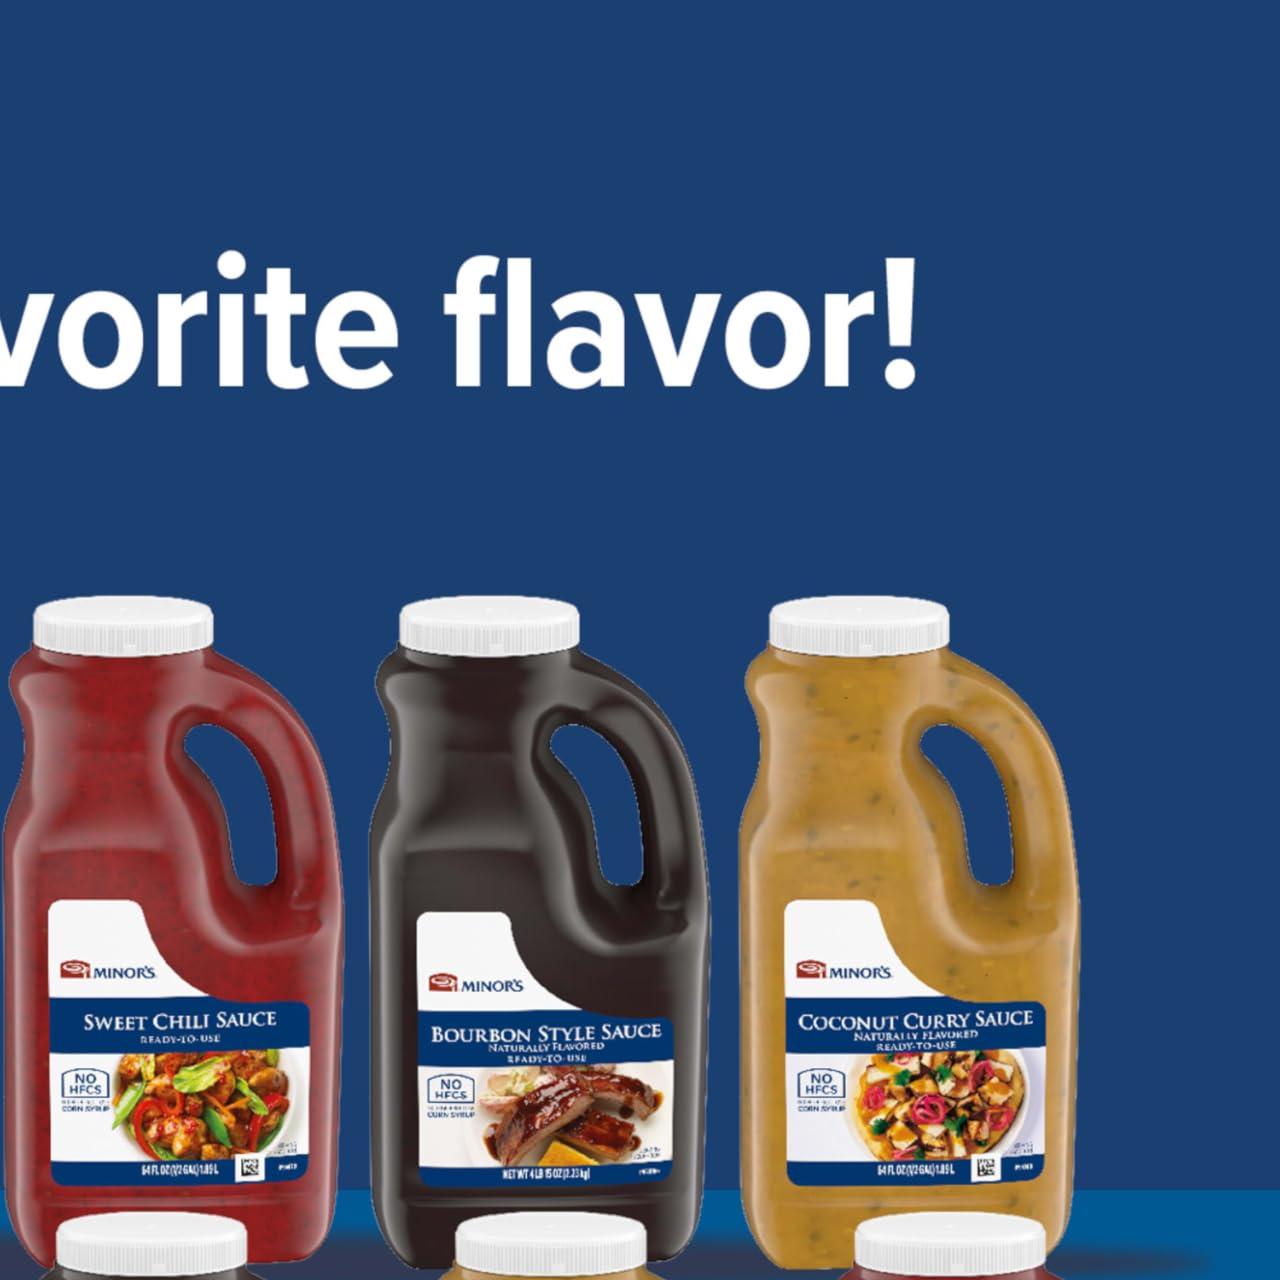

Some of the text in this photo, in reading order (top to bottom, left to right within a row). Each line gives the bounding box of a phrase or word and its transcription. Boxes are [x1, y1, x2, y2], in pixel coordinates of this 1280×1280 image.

[93, 966, 155, 979] MINOR'S
[829, 966, 891, 979] MINOR'S
[461, 979, 523, 993] MINOR'S
[84, 1011, 277, 1031] SWEET CHILI SAUCE
[798, 1010, 1033, 1031] COCONUT CURRY SAUCE
[431, 1024, 662, 1043] BOURBON STYLE SAUCE
[75, 1073, 96, 1084] NO
[441, 1079, 461, 1090] NO
[811, 1073, 832, 1084] NO
[70, 1085, 102, 1094] HFCS
[435, 1091, 467, 1100] HFCS
[806, 1085, 838, 1094] HFCS
